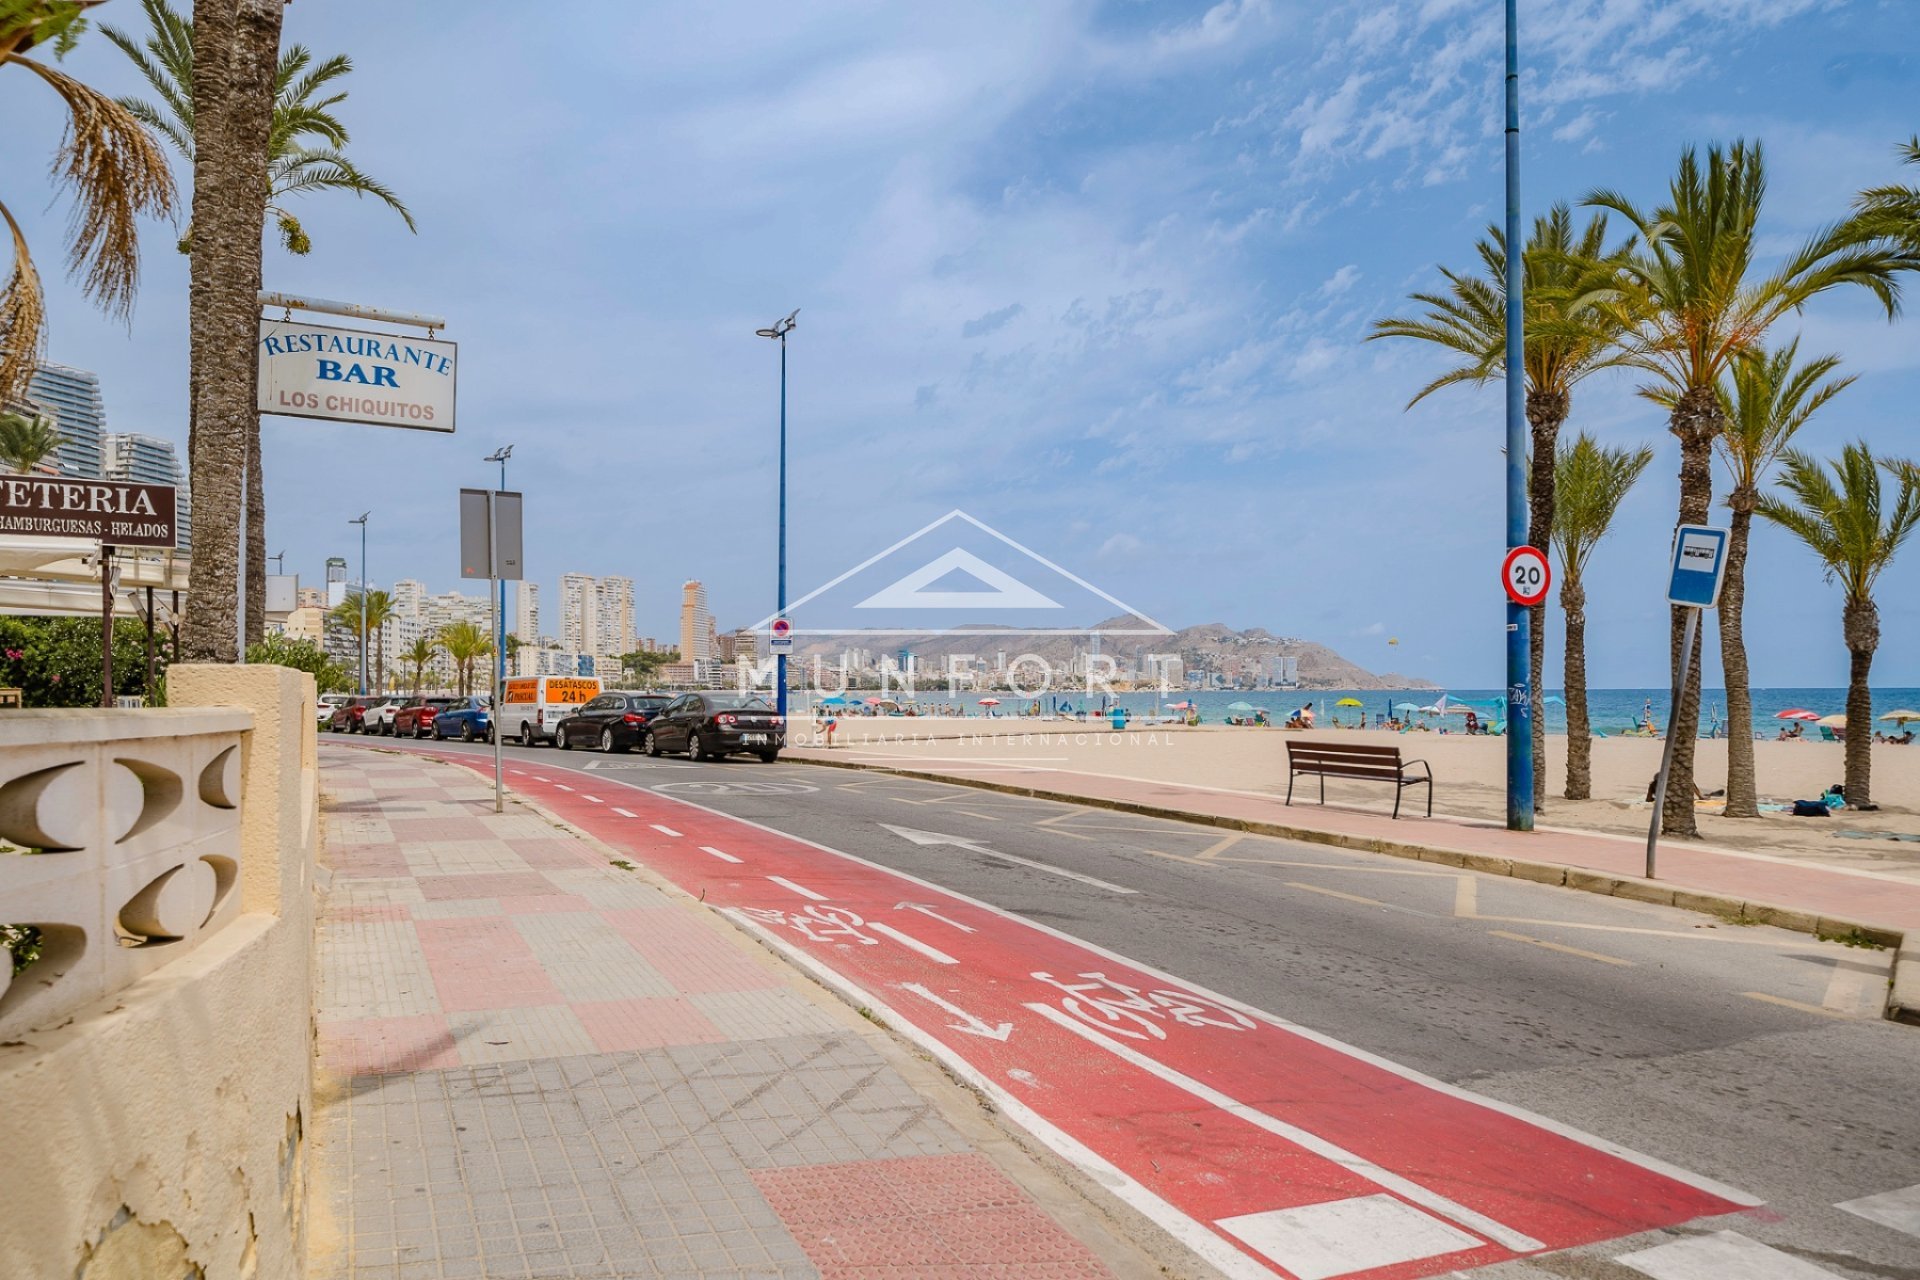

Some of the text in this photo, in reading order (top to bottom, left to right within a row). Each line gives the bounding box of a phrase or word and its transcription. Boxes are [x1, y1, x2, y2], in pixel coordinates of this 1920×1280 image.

[264, 334, 453, 376] RESTAURANTE
[316, 359, 400, 388] BAR
[279, 390, 435, 420] LOS CHIQUITOS
[0, 480, 157, 516] ETERIA
[111, 521, 168, 538] HELADOS
[1515, 565, 1541, 585] 20
[549, 680, 597, 690] DESATASCOS
[561, 690, 587, 702] 24 h
